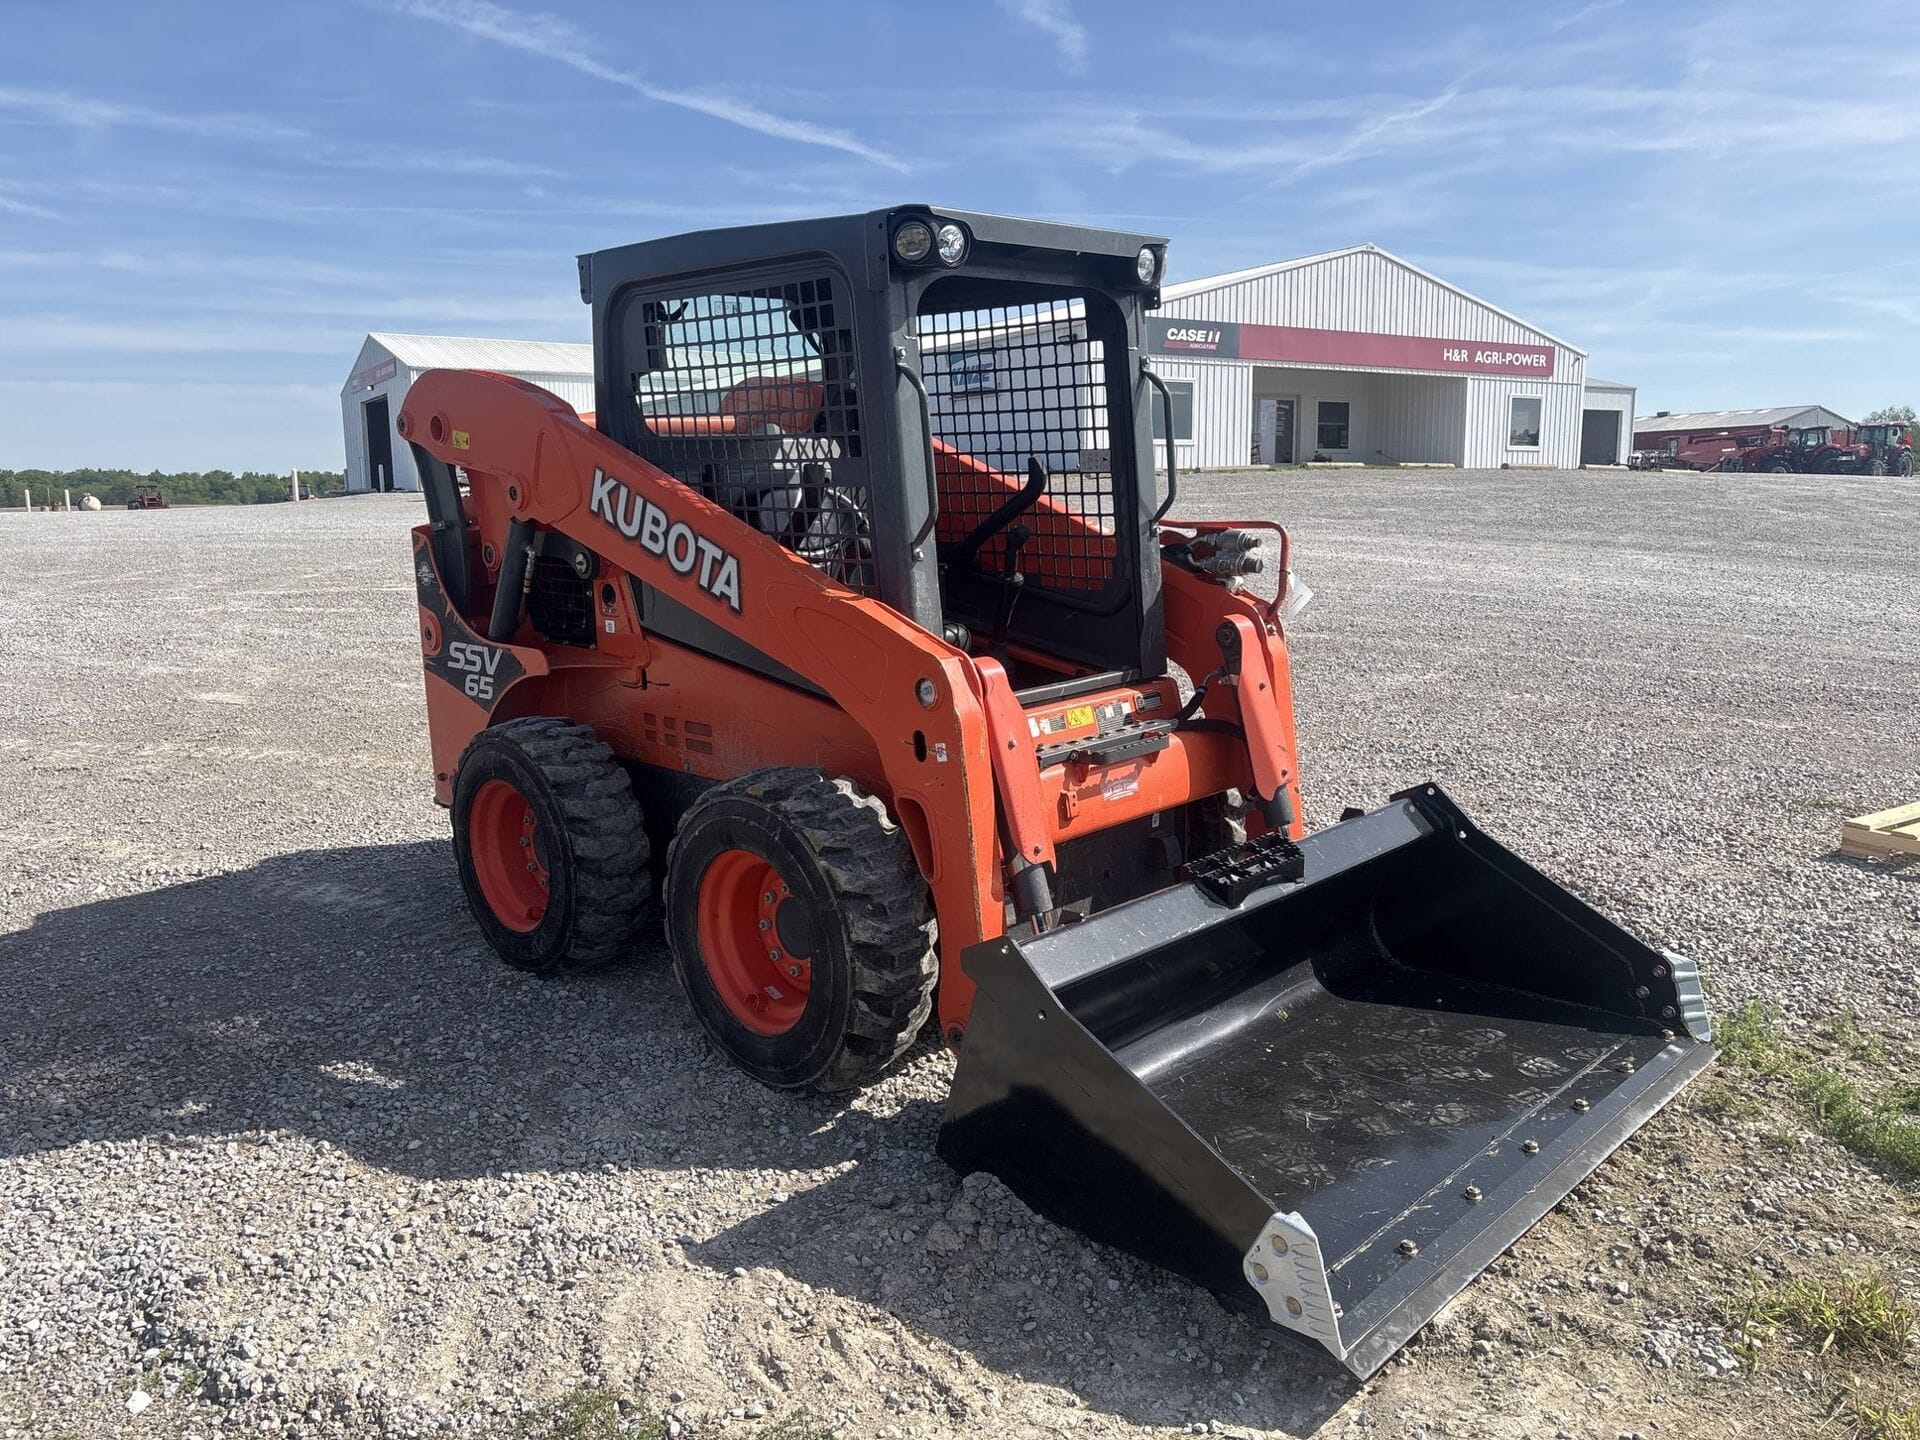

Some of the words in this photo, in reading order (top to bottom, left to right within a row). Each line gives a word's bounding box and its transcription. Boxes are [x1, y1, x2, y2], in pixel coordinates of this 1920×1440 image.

[1166, 327, 1207, 342] CASE
[1443, 348, 1468, 362] H&R
[1474, 350, 1547, 367] AGRI-POWER
[590, 468, 741, 612] KUBOTA
[447, 641, 503, 675] SSV
[464, 673, 494, 700] 65
